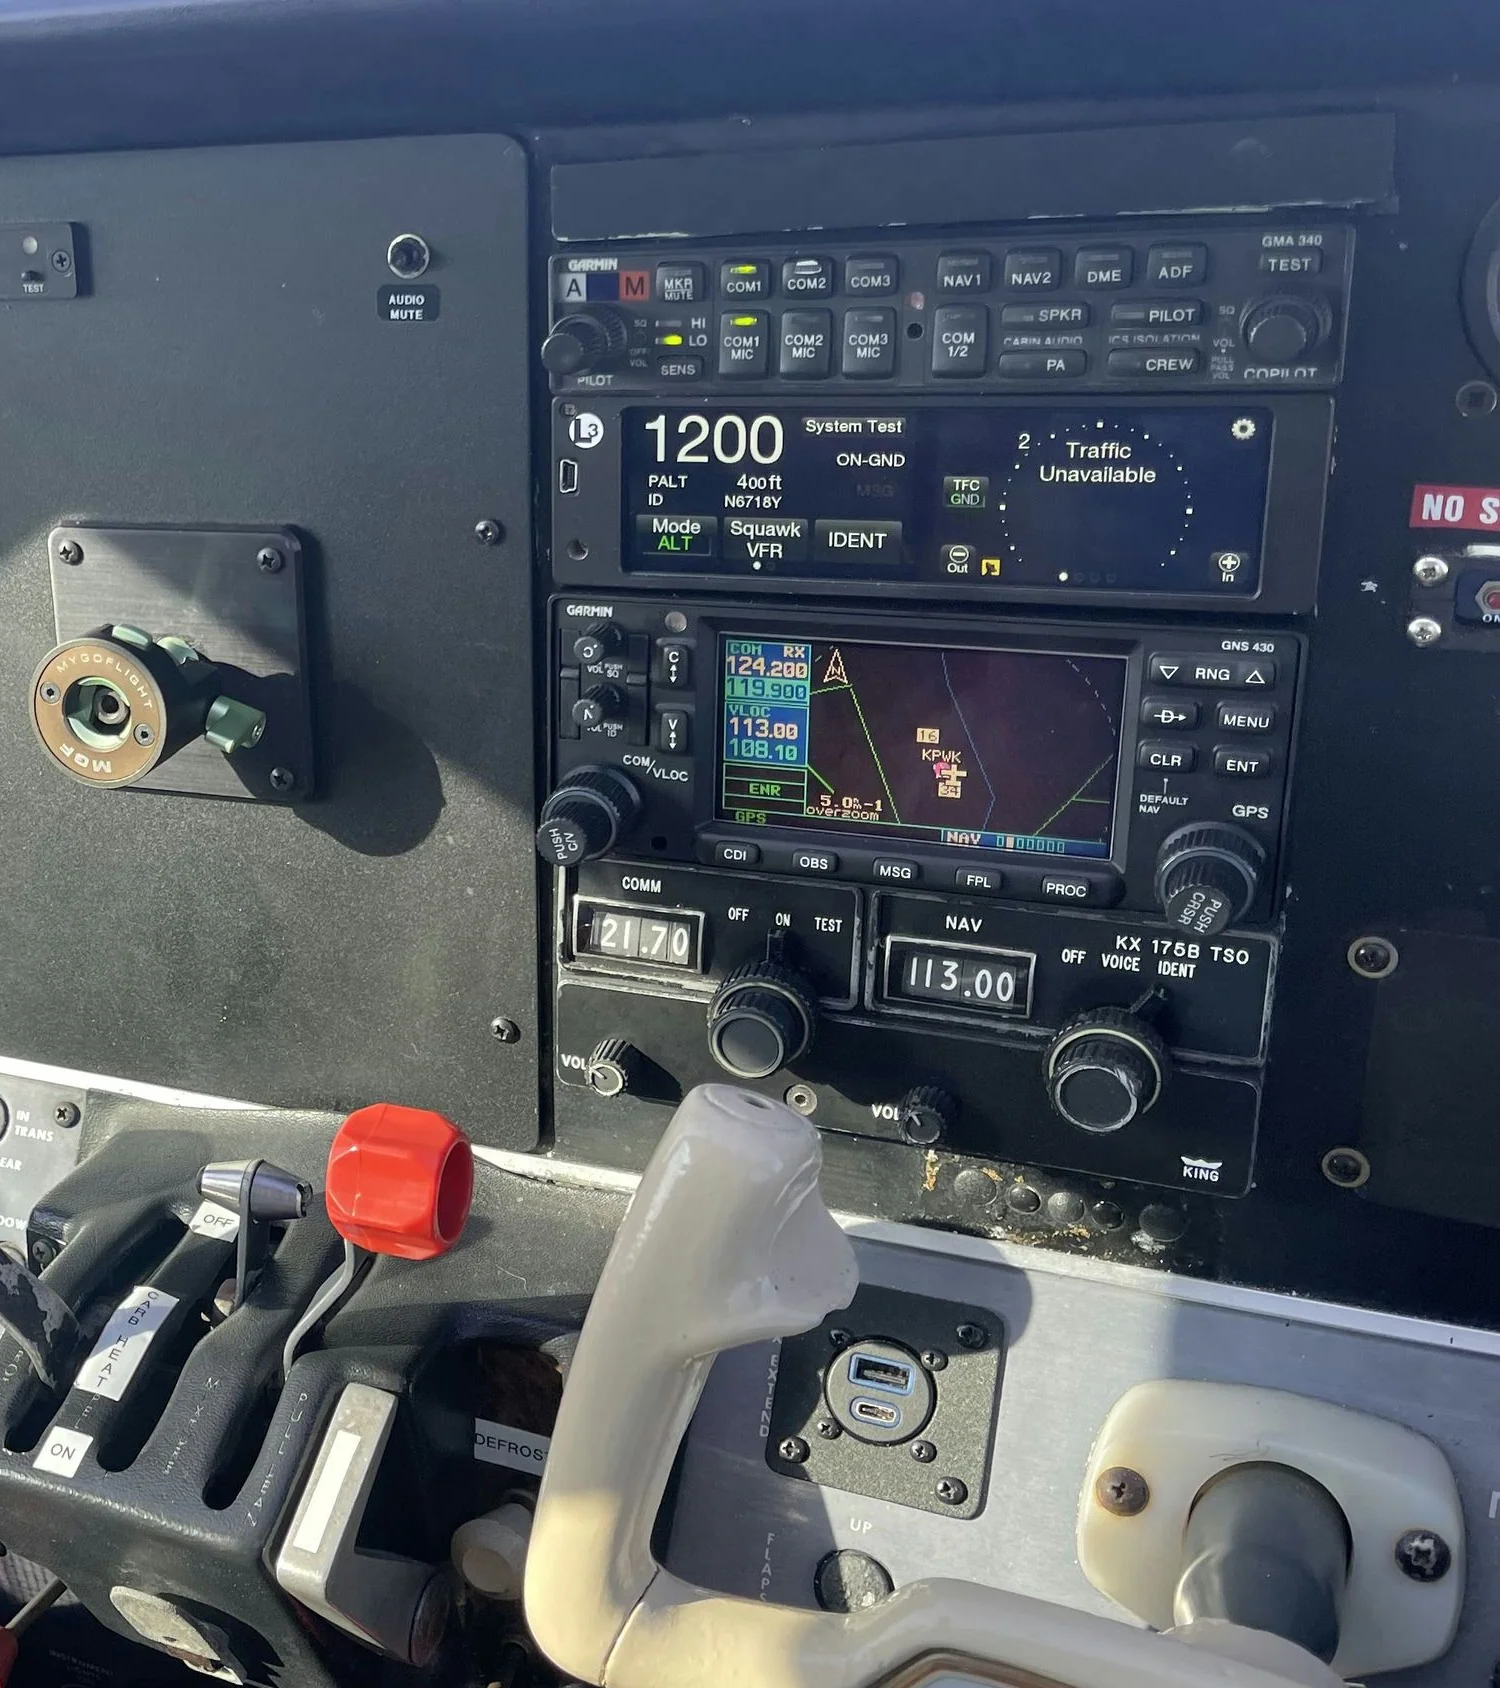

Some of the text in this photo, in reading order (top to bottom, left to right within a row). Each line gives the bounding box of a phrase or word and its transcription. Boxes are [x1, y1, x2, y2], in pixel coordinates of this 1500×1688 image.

[1262, 235, 1323, 248] GMA 340
[568, 258, 618, 272] GARMIN
[1158, 265, 1193, 279] ADF
[1268, 258, 1311, 272] TEST
[850, 275, 891, 288] COM3
[943, 273, 982, 288] NAV1
[1011, 271, 1052, 285] NAV2
[1087, 269, 1122, 283] DME
[22, 283, 44, 293] TEST
[566, 279, 582, 296] A
[624, 276, 645, 295] M
[664, 277, 693, 290] MKR
[726, 281, 763, 293] COM1
[787, 277, 827, 291] COM2
[388, 294, 425, 305] AUDIO
[664, 290, 693, 301] MUTE
[390, 309, 423, 320] MUTE
[1038, 308, 1082, 323] SPKR
[1149, 308, 1195, 323] PILOT
[691, 318, 706, 329] HI
[689, 335, 708, 347] LO
[723, 335, 760, 348] COM1
[785, 334, 824, 347] COM2
[849, 332, 888, 346] COM3
[942, 332, 975, 345] COM
[731, 348, 754, 361] MIC
[791, 346, 815, 359] MIC
[856, 345, 881, 358] MIC
[947, 345, 968, 358] 1/2
[660, 363, 696, 377] SENS
[1046, 359, 1065, 372] PA
[1145, 358, 1194, 371] CREW
[577, 374, 613, 387] PILOT
[805, 420, 903, 435] System Test
[645, 414, 784, 465] 1200
[1018, 433, 1031, 450] 2
[1066, 442, 1132, 459] Traffic
[836, 454, 906, 468] ON-GND
[1039, 465, 1156, 484] Unavailable
[648, 475, 688, 489] PALT
[953, 479, 980, 492] TFC
[648, 493, 781, 509] ID N6718Y
[950, 493, 980, 506] GND
[1422, 493, 1465, 522] NO
[652, 519, 701, 535] Mode
[730, 520, 801, 541] Squawk
[658, 535, 692, 551] ALT
[828, 531, 887, 549] IDENT
[747, 542, 783, 559] VFR
[947, 562, 968, 574] Out
[1221, 571, 1234, 583] In
[566, 605, 613, 618] GARMIN
[730, 643, 805, 658] COM RX
[1221, 640, 1275, 653] GNS 430
[669, 651, 679, 664] C
[587, 665, 604, 674] VOL
[726, 656, 808, 678] 124.200
[56, 653, 153, 709] MYGOFLIGHT
[1195, 667, 1230, 682] RNG
[726, 678, 807, 700] 119.900
[729, 705, 771, 718] VLOC
[668, 719, 678, 730] V
[730, 717, 798, 740] 113.00
[1223, 714, 1270, 729] MENU
[729, 738, 798, 761] 108.10
[921, 749, 962, 763] KPWK
[59, 743, 112, 773] MGF
[1150, 753, 1182, 768] CLR
[1226, 759, 1258, 773] ENT
[749, 783, 781, 796] ENR
[1139, 794, 1189, 806] DEFAULT
[1139, 804, 1160, 815] NAV
[1232, 805, 1269, 819] GPS
[735, 811, 767, 824] GPS
[946, 831, 981, 846] NAV
[723, 848, 747, 861] CDI
[800, 856, 829, 870] OBS
[879, 865, 912, 880] MSG
[622, 877, 661, 893] COMM
[966, 875, 991, 888] FPL
[1046, 882, 1087, 897] PROC
[728, 907, 842, 932] OFF ON TEST
[1194, 899, 1223, 934] PUSH
[946, 916, 982, 933] NAV
[1116, 935, 1250, 964] KX 175B TSO
[1061, 948, 1196, 979] OFF VOICE IDENT
[910, 956, 1014, 1002] 113.00
[561, 1054, 587, 1070] VOL
[16, 1110, 30, 1123] IN
[14, 1124, 55, 1143] TRANS
[1183, 1166, 1219, 1182] KING
[203, 1212, 235, 1229] OFF
[96, 1290, 160, 1388] CARB HEAT
[759, 1357, 779, 1438] EXTEND
[50, 1443, 76, 1460] ON
[850, 1518, 873, 1534] UP
